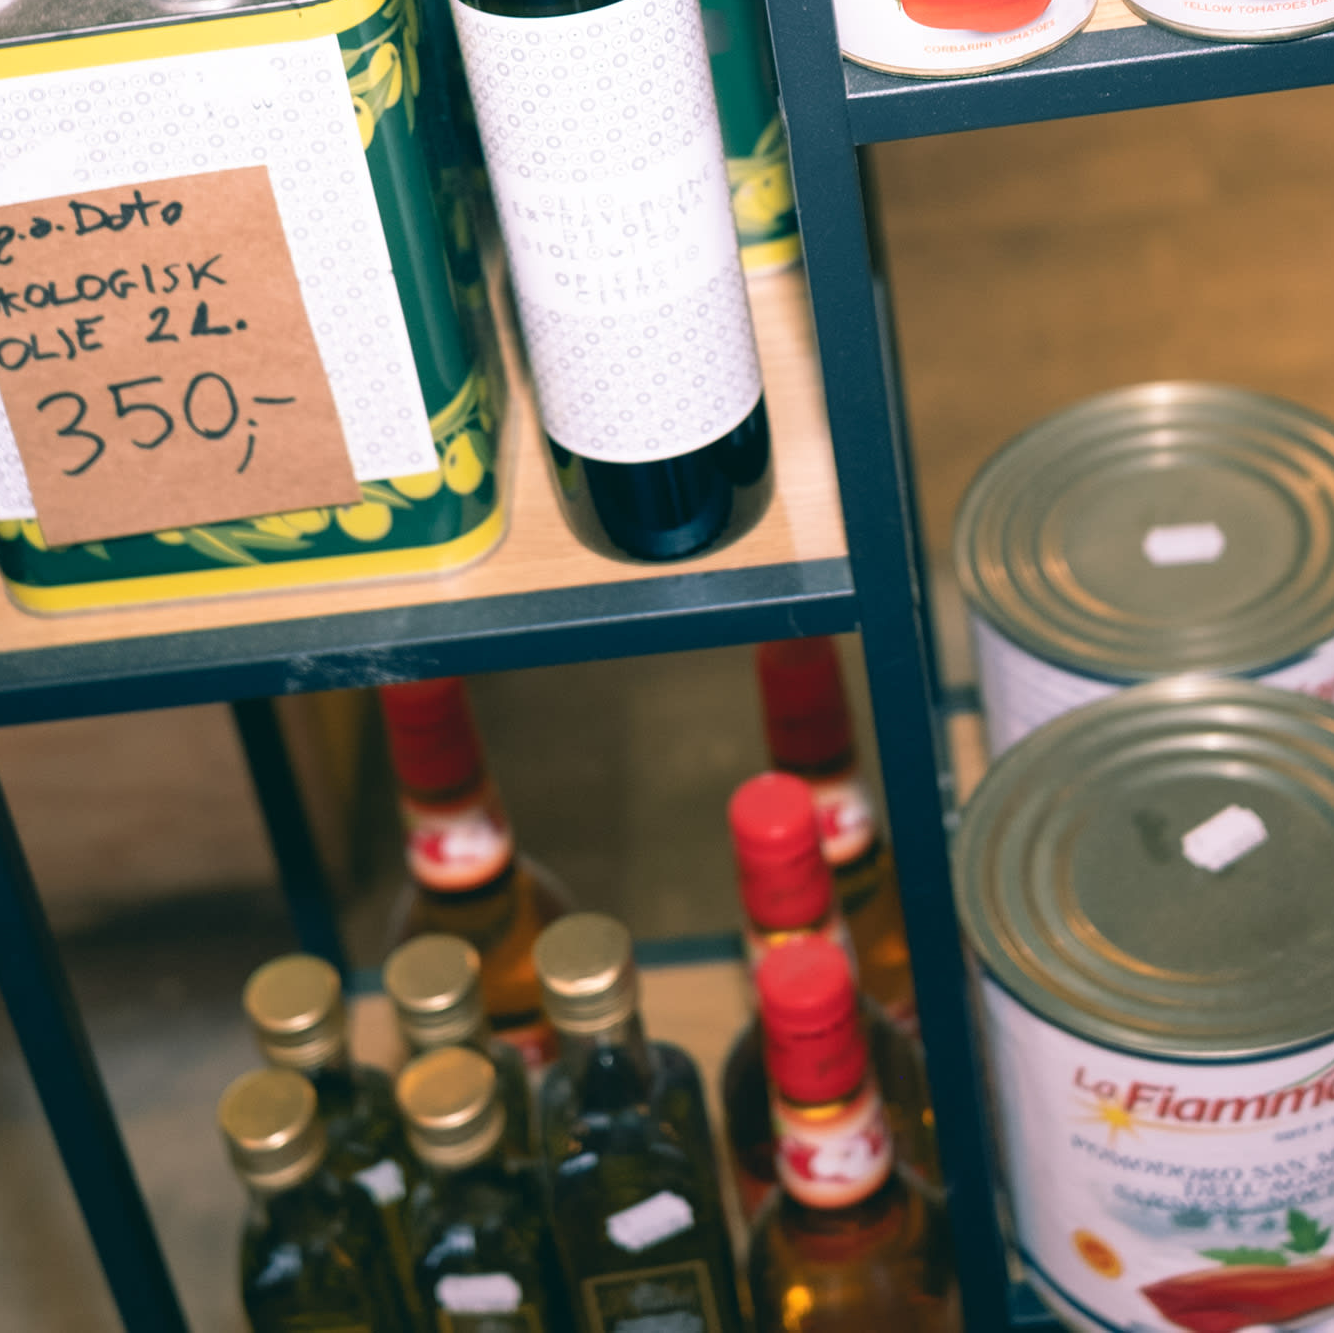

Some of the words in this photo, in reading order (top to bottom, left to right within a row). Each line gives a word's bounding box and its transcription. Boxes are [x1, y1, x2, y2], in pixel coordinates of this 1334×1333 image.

[1182, 0, 1233, 15] YELLOW
[1238, 0, 1307, 16] TOMATOES
[923, 40, 993, 55] CORBARINI
[997, 18, 1056, 47] TOMATOES
[145, 307, 179, 343] 2
[1073, 1066, 1117, 1100] La
